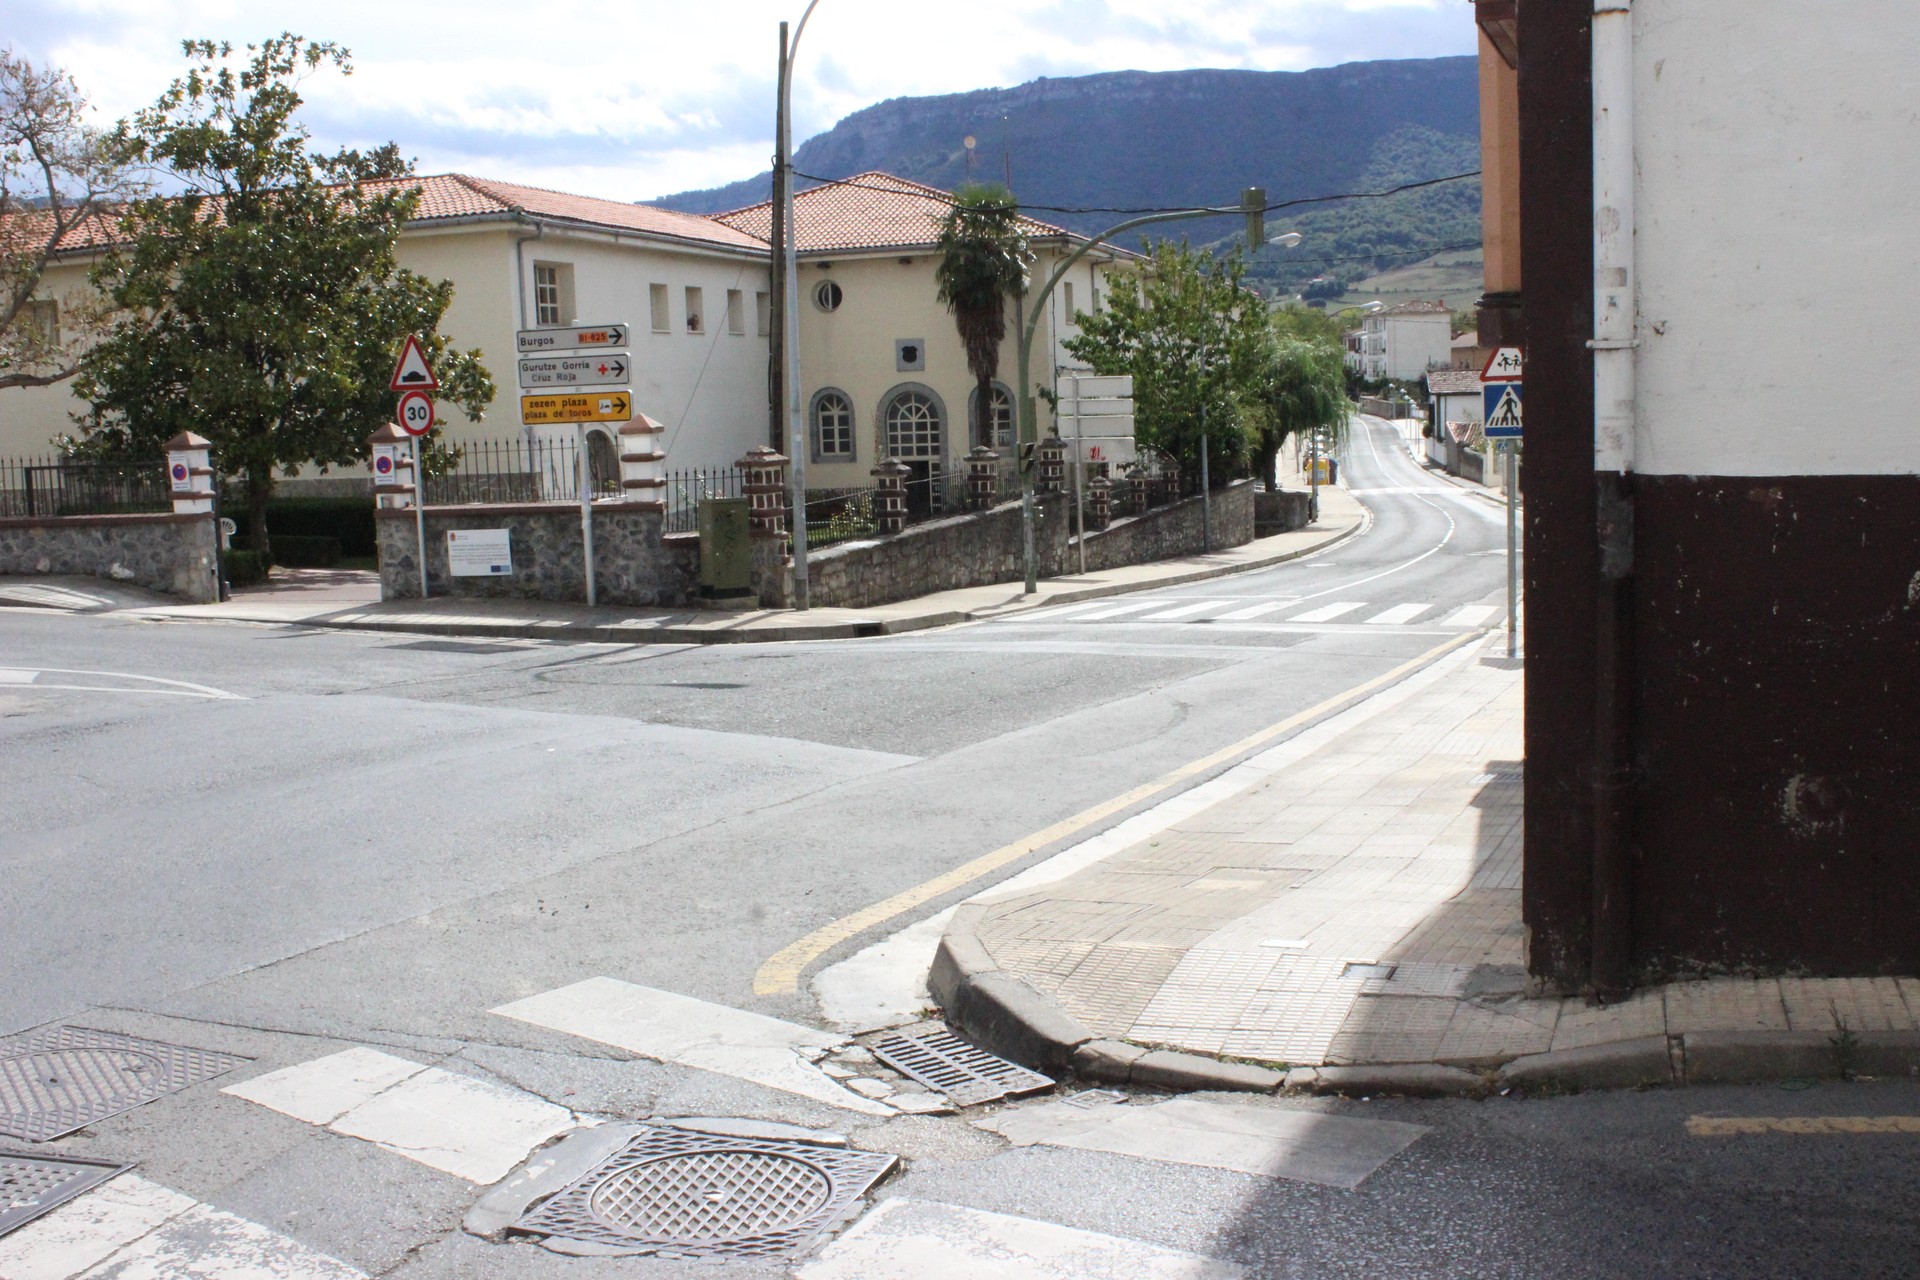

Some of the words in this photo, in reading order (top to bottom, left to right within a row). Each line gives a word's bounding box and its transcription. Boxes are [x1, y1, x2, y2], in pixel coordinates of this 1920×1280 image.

[520, 336, 555, 347] Burgos
[522, 363, 557, 372] Gurutze
[562, 361, 590, 370] Gorria
[531, 373, 552, 382] Cruz
[556, 372, 577, 382] Roja
[529, 400, 556, 408] zezen
[562, 397, 588, 408] plaza
[408, 406, 426, 420] 30
[524, 410, 547, 420] plaza
[553, 409, 564, 418] de
[569, 408, 592, 417] toros
